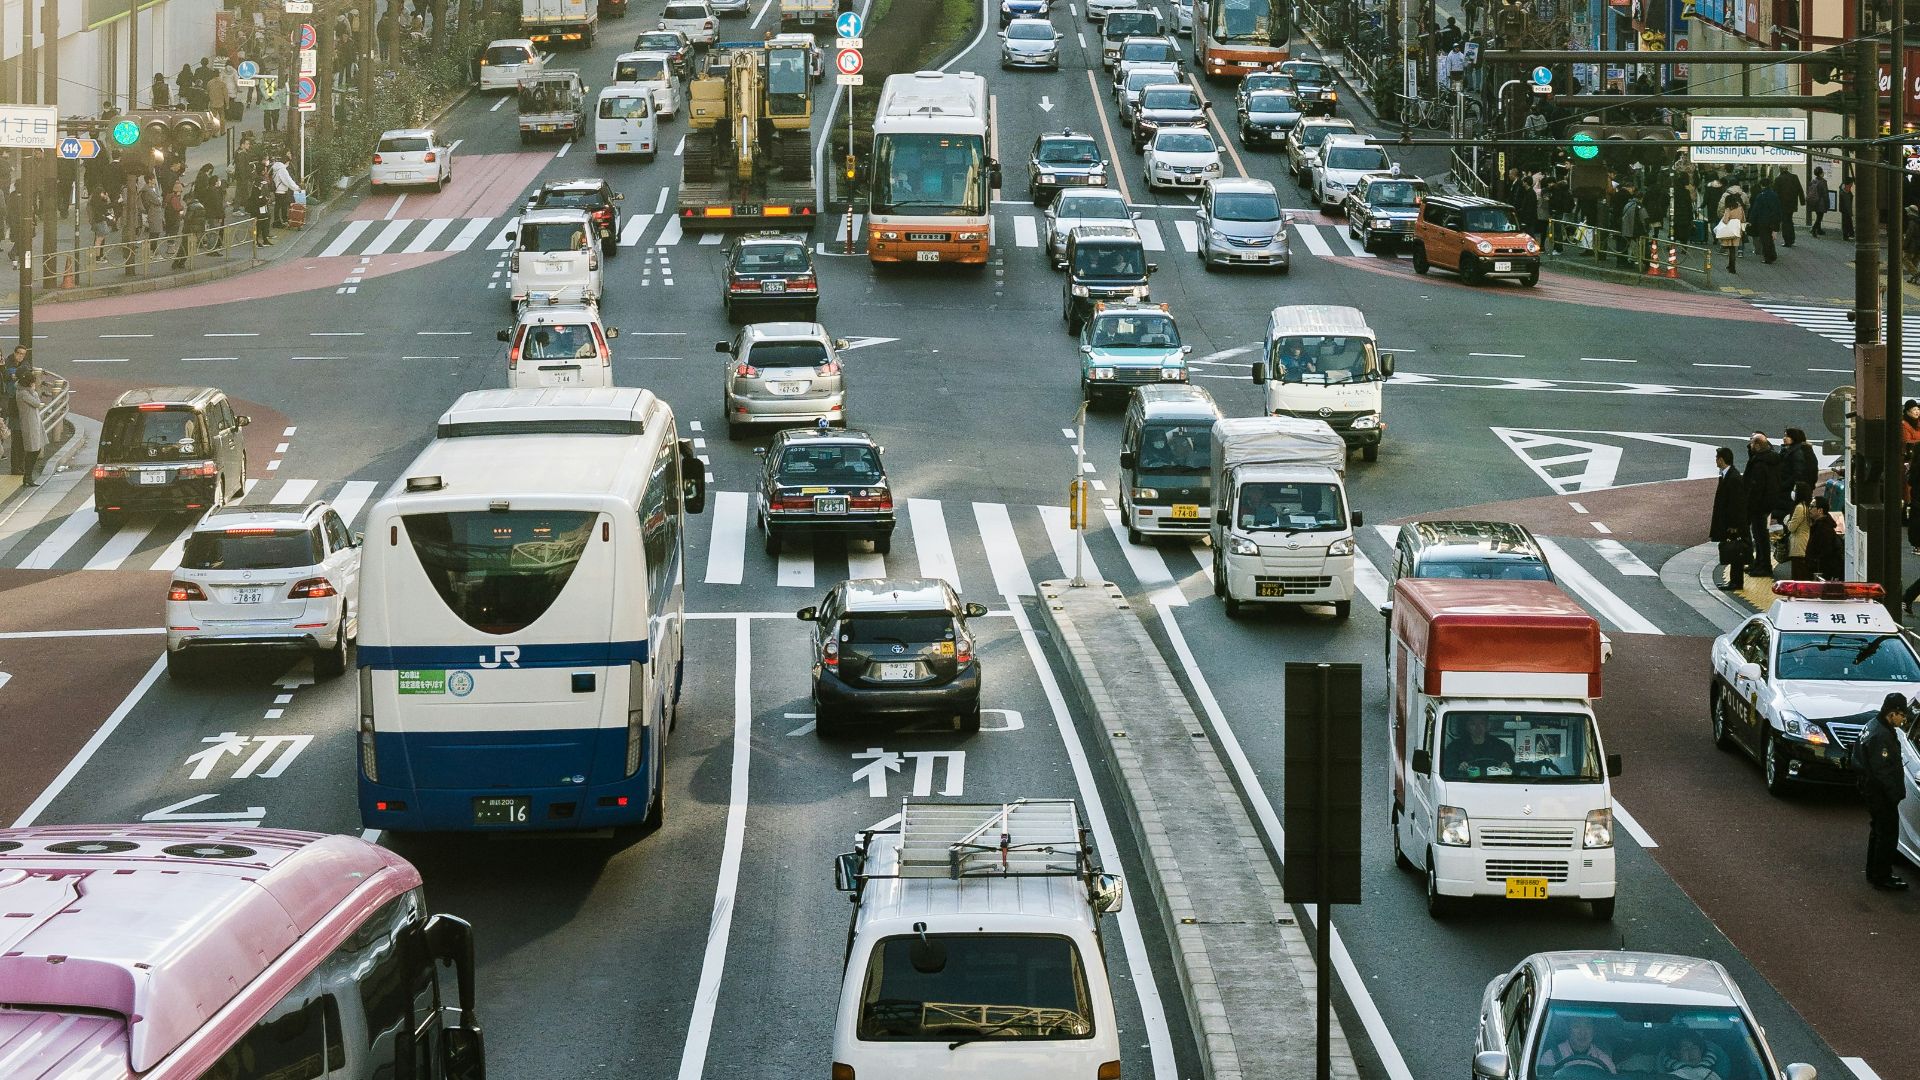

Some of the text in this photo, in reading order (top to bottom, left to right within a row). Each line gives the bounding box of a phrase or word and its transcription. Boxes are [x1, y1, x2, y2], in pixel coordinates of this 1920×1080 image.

[1701, 126, 1796, 141] 西新宿一丁目
[63, 143, 79, 153] 414
[1695, 146, 1757, 157] Nishishinjuku
[1178, 510, 1197, 518] 74-08
[239, 593, 261, 602] 78-87
[1803, 612, 1871, 625] 警視庁
[479, 645, 521, 668] JR
[1722, 685, 1748, 724] POLICE
[509, 805, 527, 822] 16
